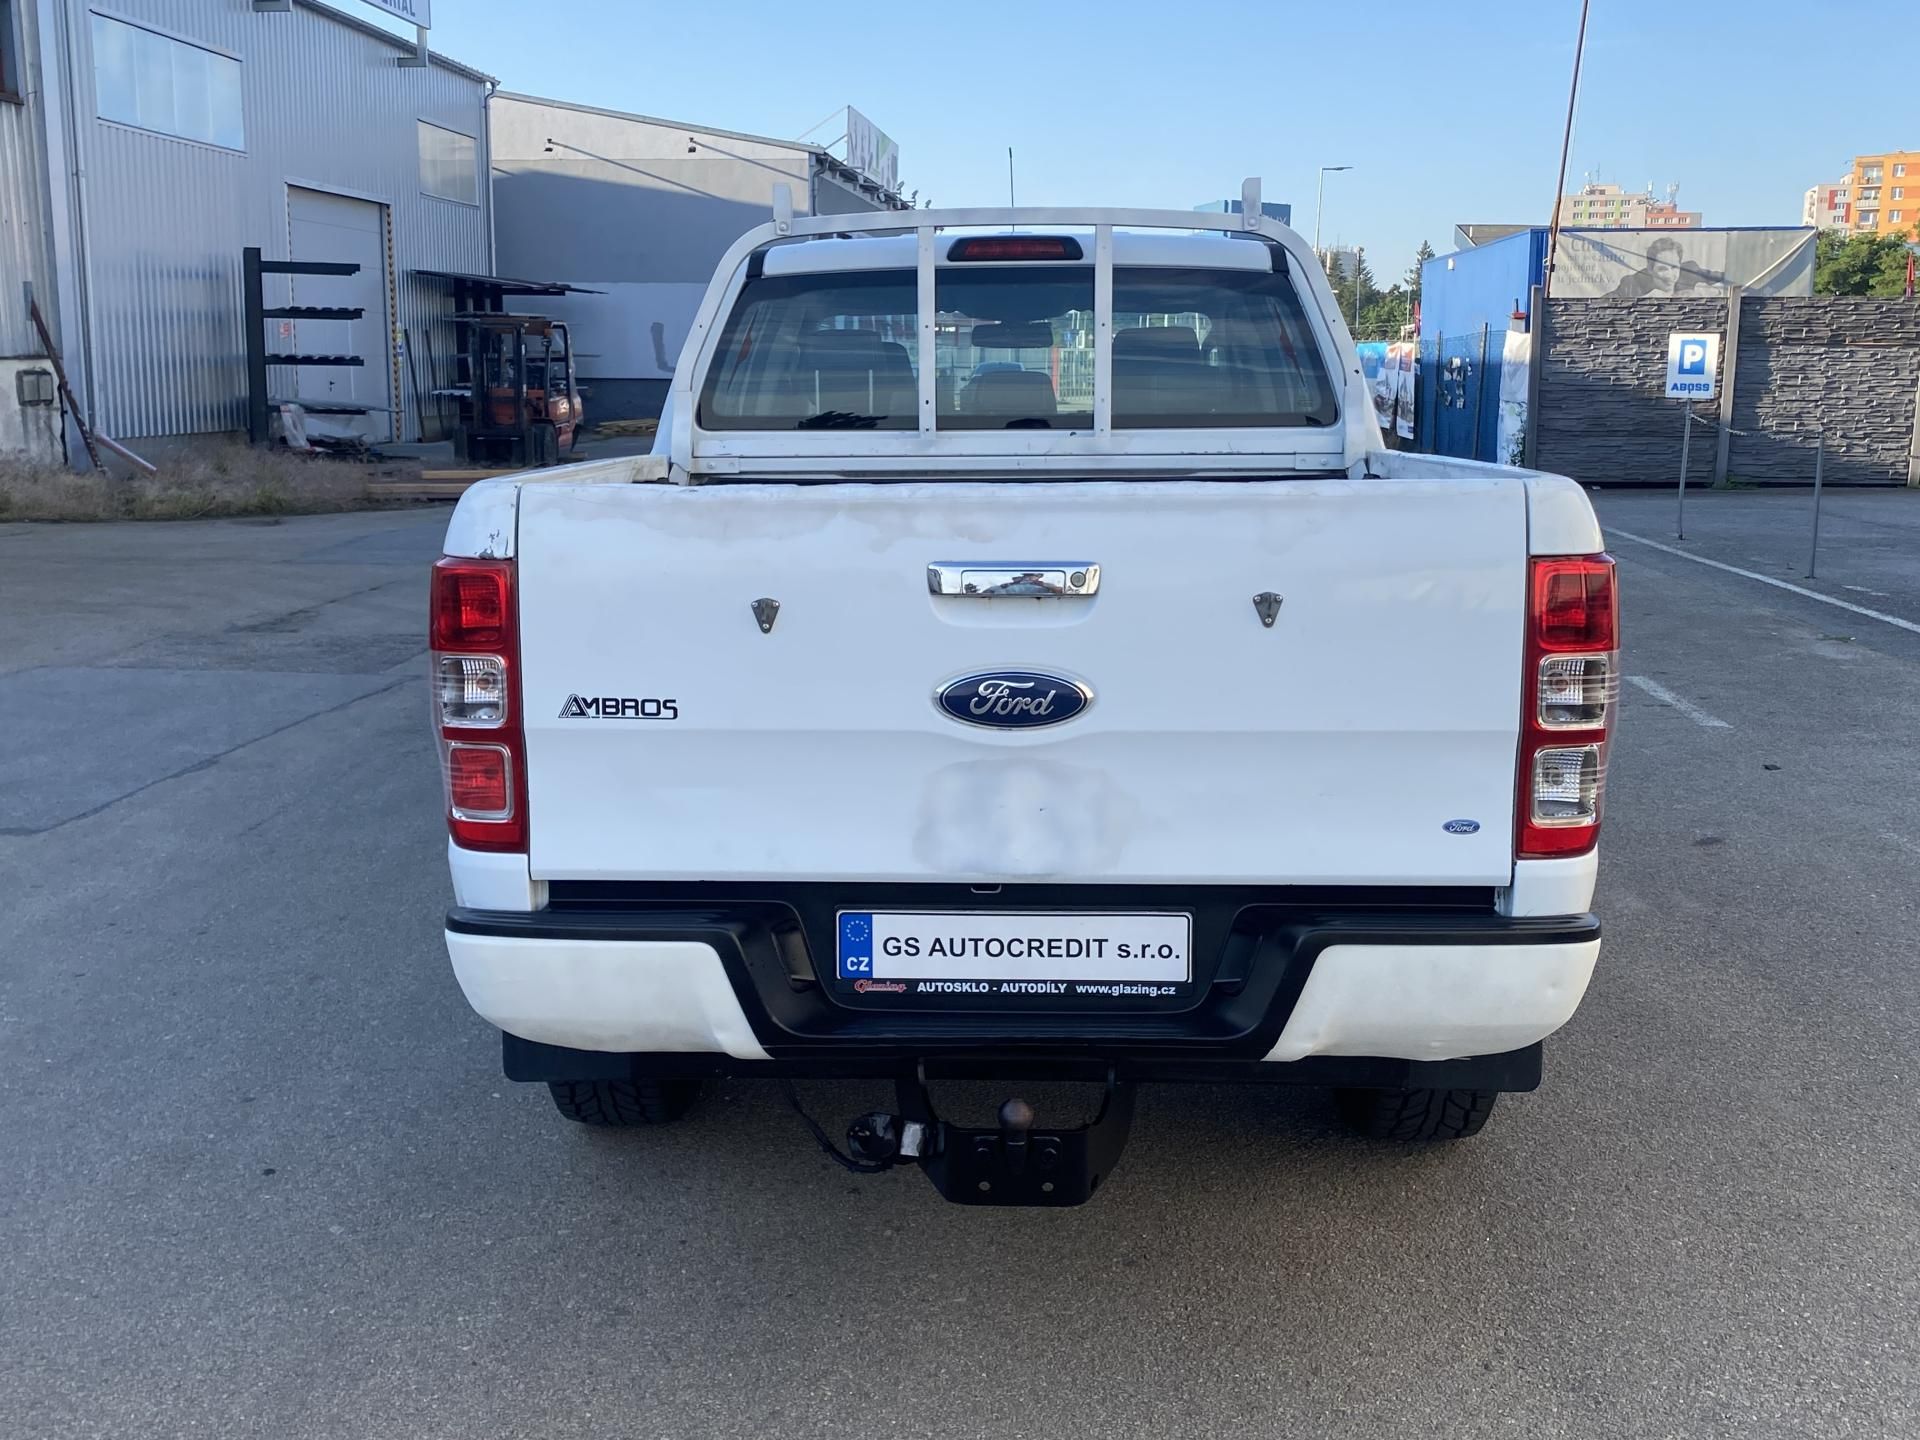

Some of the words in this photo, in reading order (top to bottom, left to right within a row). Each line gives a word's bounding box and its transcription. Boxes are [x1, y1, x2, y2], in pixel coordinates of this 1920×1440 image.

[1683, 344, 1704, 370] P
[1670, 382, 1710, 392] ABOSS
[558, 693, 679, 720] AMBROS
[969, 680, 1057, 716] Ford
[882, 936, 921, 957] GS
[927, 937, 1109, 959] AUTOCREDIT
[1116, 943, 1181, 960] s.r.o.
[846, 956, 870, 972] CZ
[917, 981, 990, 993] AUTOSKLO
[1000, 980, 1068, 994] AUTODÍLY
[1075, 983, 1177, 997] www.glazing.cz
